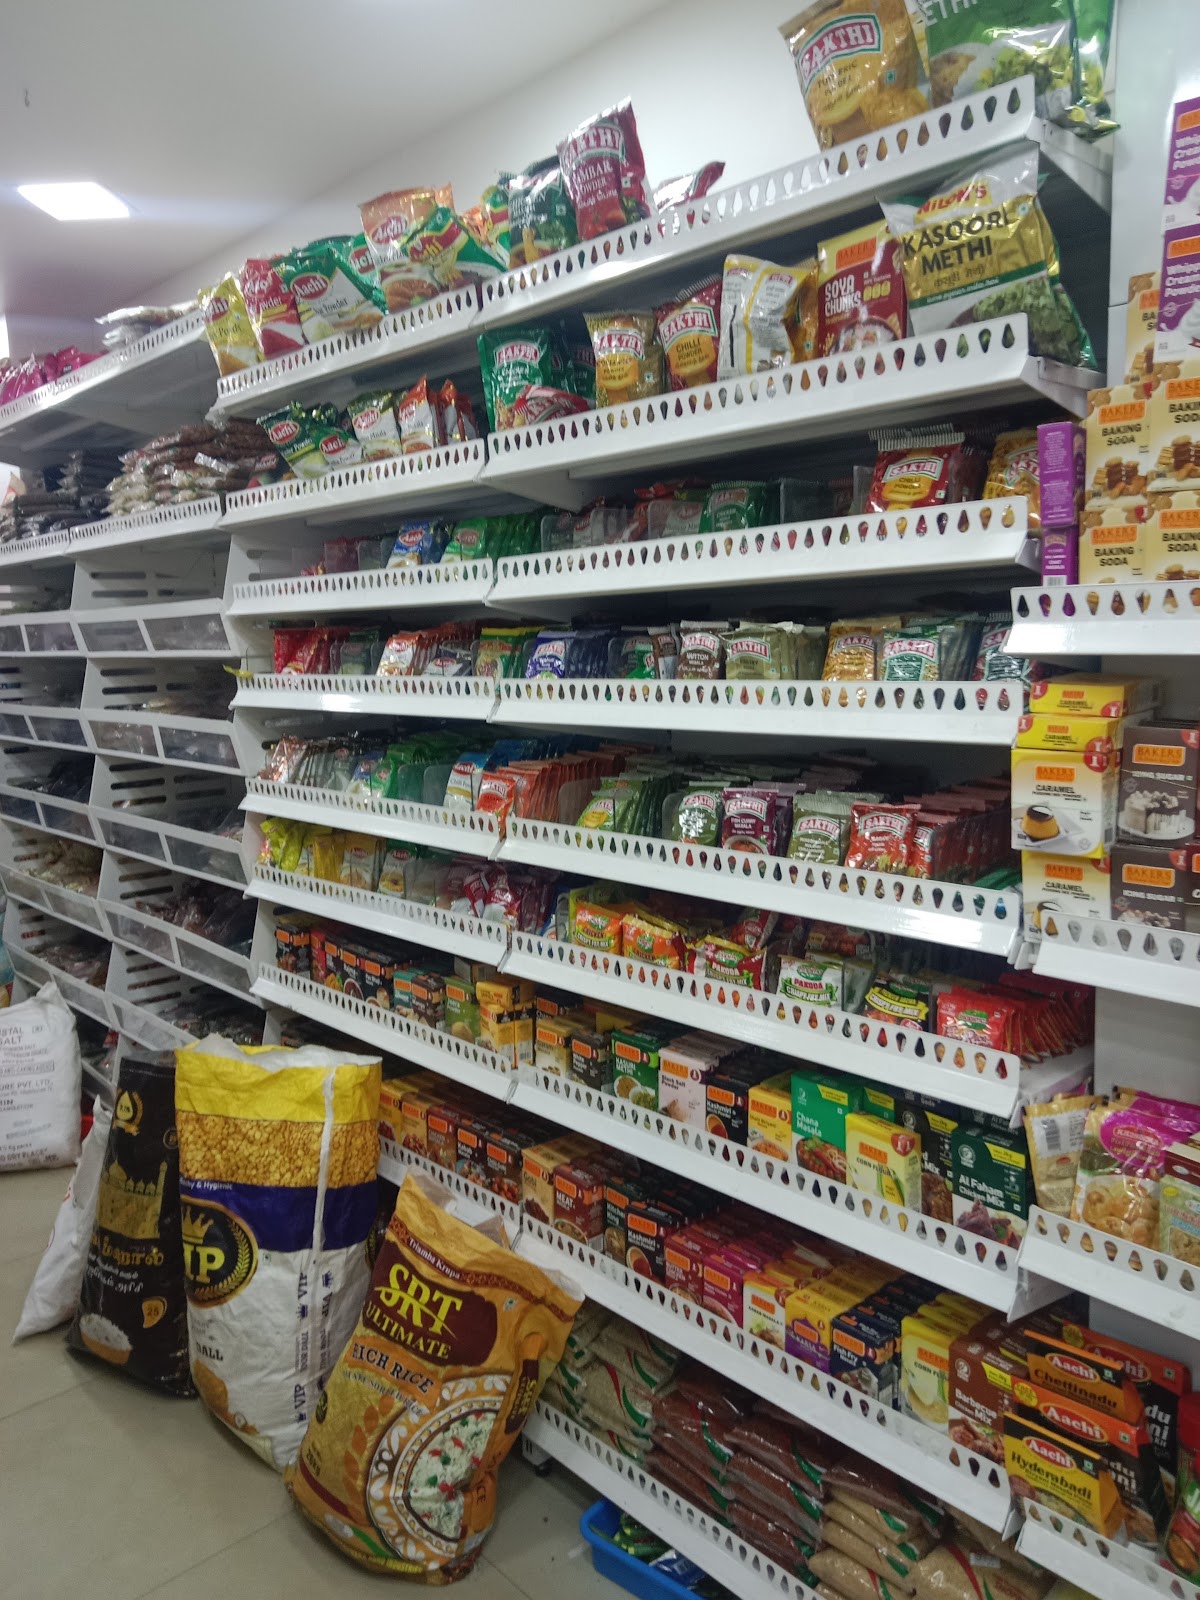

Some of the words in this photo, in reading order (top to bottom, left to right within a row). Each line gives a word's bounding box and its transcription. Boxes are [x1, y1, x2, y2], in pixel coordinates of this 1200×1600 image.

[801, 20, 877, 79] SAKTHI
[903, 211, 1007, 256] KASOORI
[921, 237, 992, 276] METHI
[295, 277, 326, 297] Aachi
[825, 274, 854, 301] SOYA
[825, 291, 861, 317] CHUNKS
[662, 312, 711, 343] SAKTHI
[1102, 424, 1141, 437] BAKING
[1107, 433, 1135, 447] SODA
[890, 461, 938, 478] SAKTHI
[1095, 547, 1134, 560] BAKING
[1168, 544, 1198, 557] SODA
[1100, 557, 1128, 570] SODA
[731, 640, 768, 657] SAKTHI
[1138, 750, 1184, 763] BAKERS
[1036, 783, 1075, 794] CARAMEL
[865, 815, 905, 833] SAKTHI
[1046, 881, 1083, 894] CARAMEL
[712, 962, 740, 976] PAKODA
[794, 978, 824, 990] PAKODA
[797, 1111, 819, 1128] Chana
[797, 1122, 822, 1139] Masala
[556, 1190, 575, 1206] MEAT
[971, 1178, 1003, 1199] Faham
[606, 1202, 625, 1216] Kitche
[986, 1194, 1005, 1209] Mix
[409, 1238, 435, 1265] Triamba
[435, 1256, 461, 1279] Krupa
[298, 1272, 308, 1300] VIP
[374, 1263, 464, 1337] SRT
[365, 1301, 452, 1361] ULTIMATE
[833, 1345, 848, 1358] Fish
[848, 1351, 858, 1364] Fry
[1051, 1355, 1095, 1380] Aachi
[390, 1362, 434, 1393] RICE
[294, 1383, 307, 1410] VIP
[1034, 1368, 1118, 1409] Chettinadu
[955, 1387, 998, 1420] Barbecue
[974, 1409, 993, 1426] Mix
[1047, 1406, 1103, 1439] Aachi
[1028, 1438, 1072, 1467] Aachi
[1010, 1450, 1092, 1500] Hyderabadi
